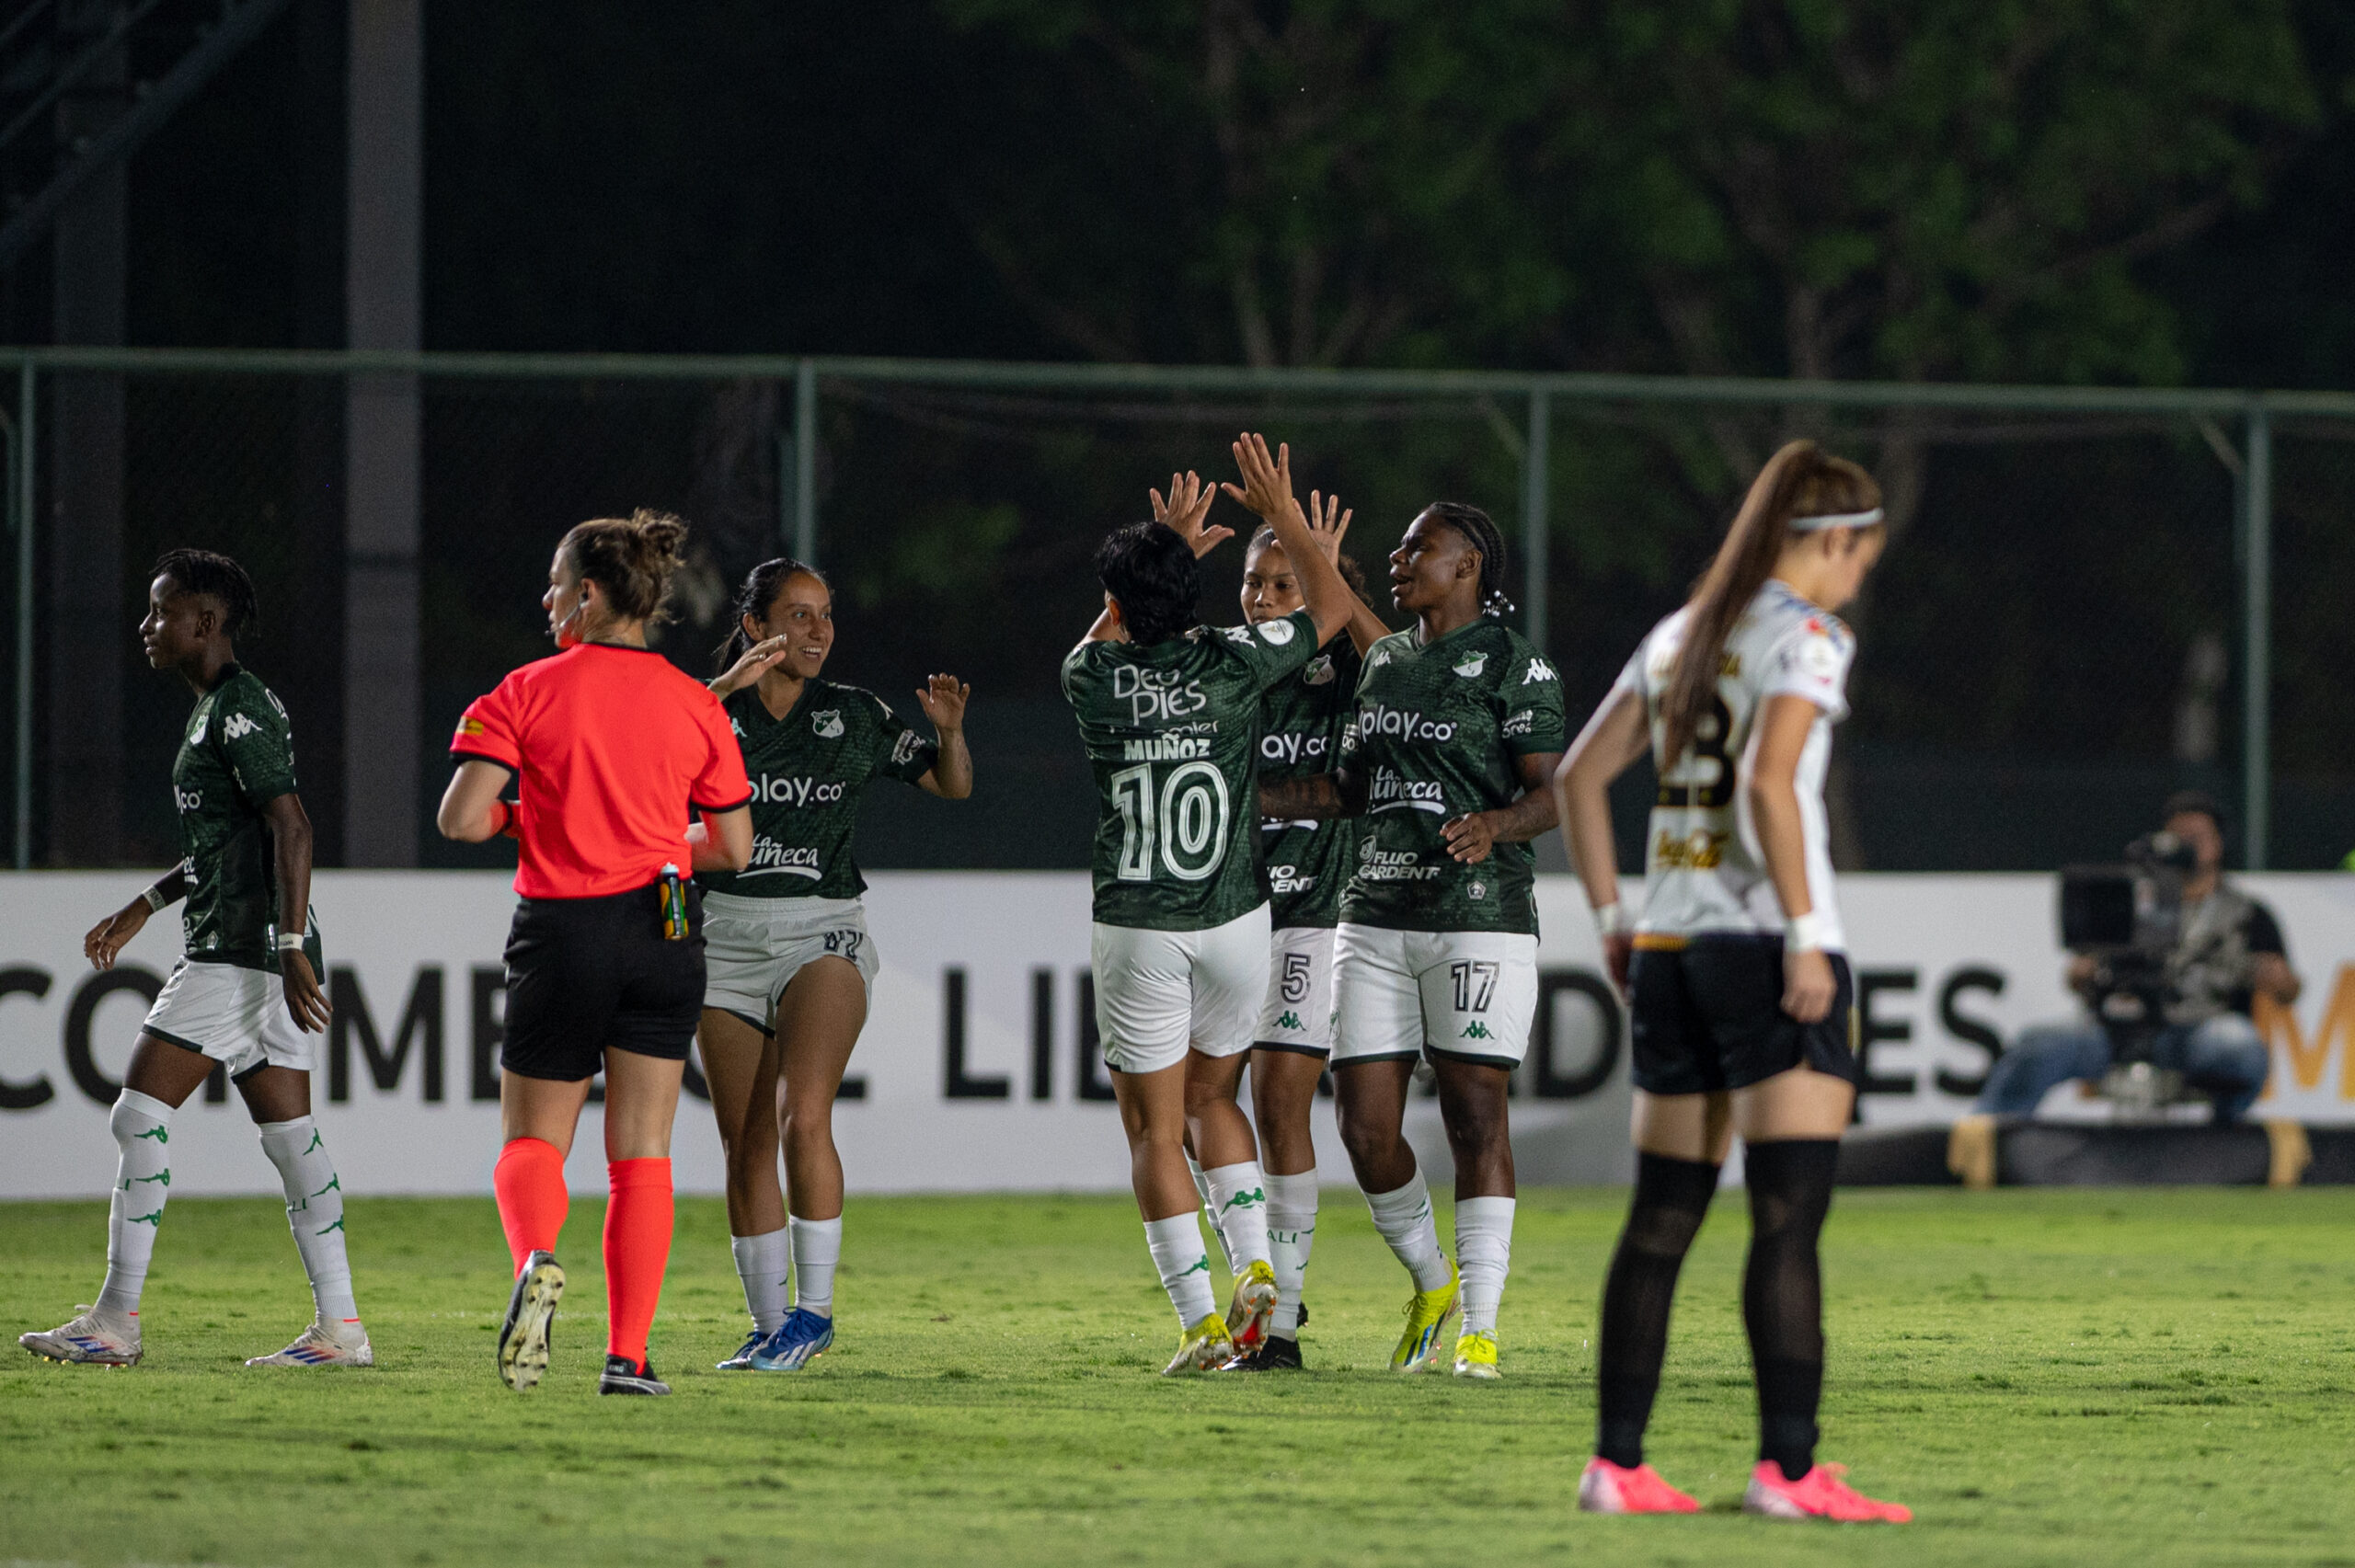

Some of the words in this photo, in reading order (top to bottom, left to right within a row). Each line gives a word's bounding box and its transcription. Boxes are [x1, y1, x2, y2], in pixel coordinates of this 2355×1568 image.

[1359, 704, 1452, 742] play.co
[1123, 732, 1210, 761] MUÑOZ
[1110, 761, 1229, 881] 10
[749, 841, 819, 866] uñeca
[1373, 851, 1419, 865] FLUO
[1281, 952, 1312, 1004] 5
[1451, 960, 1500, 1013] 17
[1267, 1229, 1297, 1243] ALI
